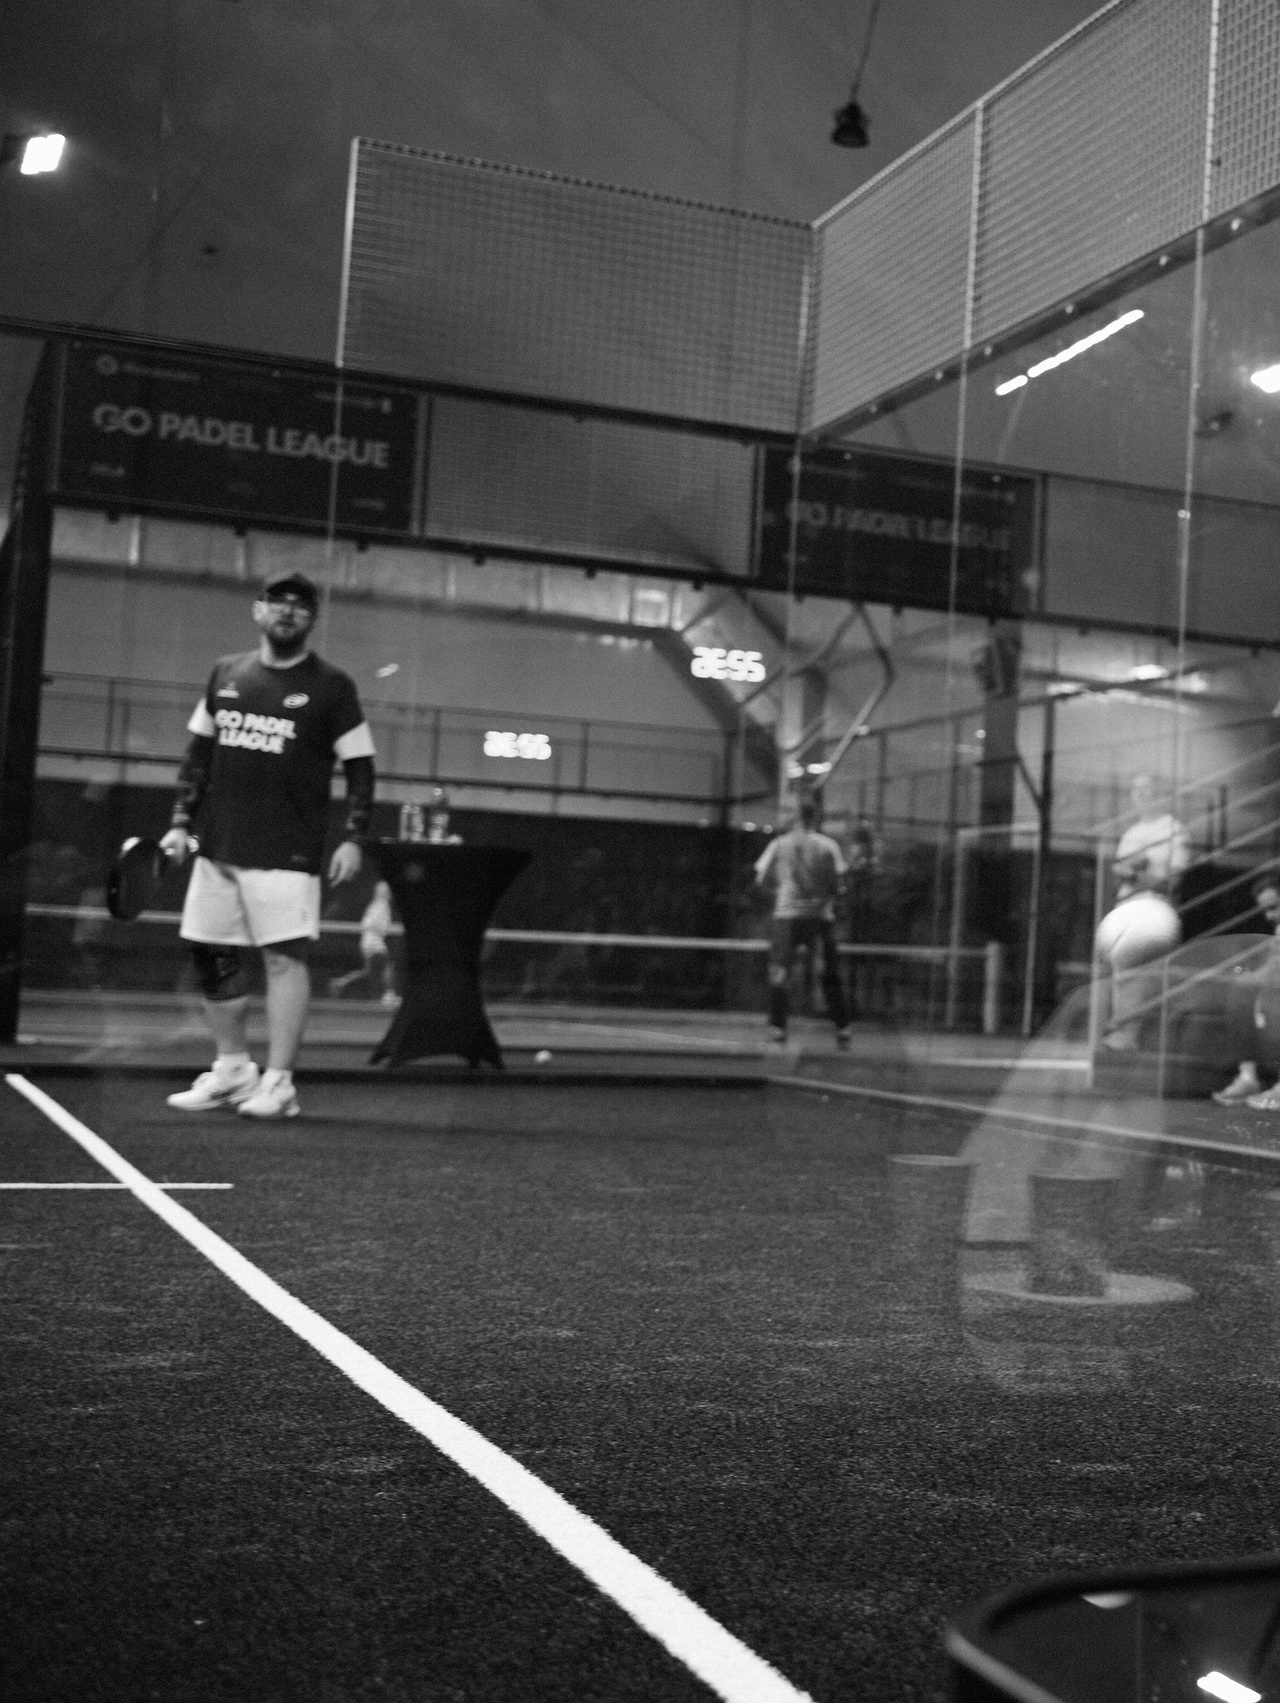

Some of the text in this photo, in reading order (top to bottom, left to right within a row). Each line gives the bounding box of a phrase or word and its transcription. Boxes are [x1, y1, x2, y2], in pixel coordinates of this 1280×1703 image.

[92, 402, 390, 468] GO PADEL LEAGUE
[215, 708, 297, 739] GO PADEL
[219, 728, 285, 755] LEAGUE
